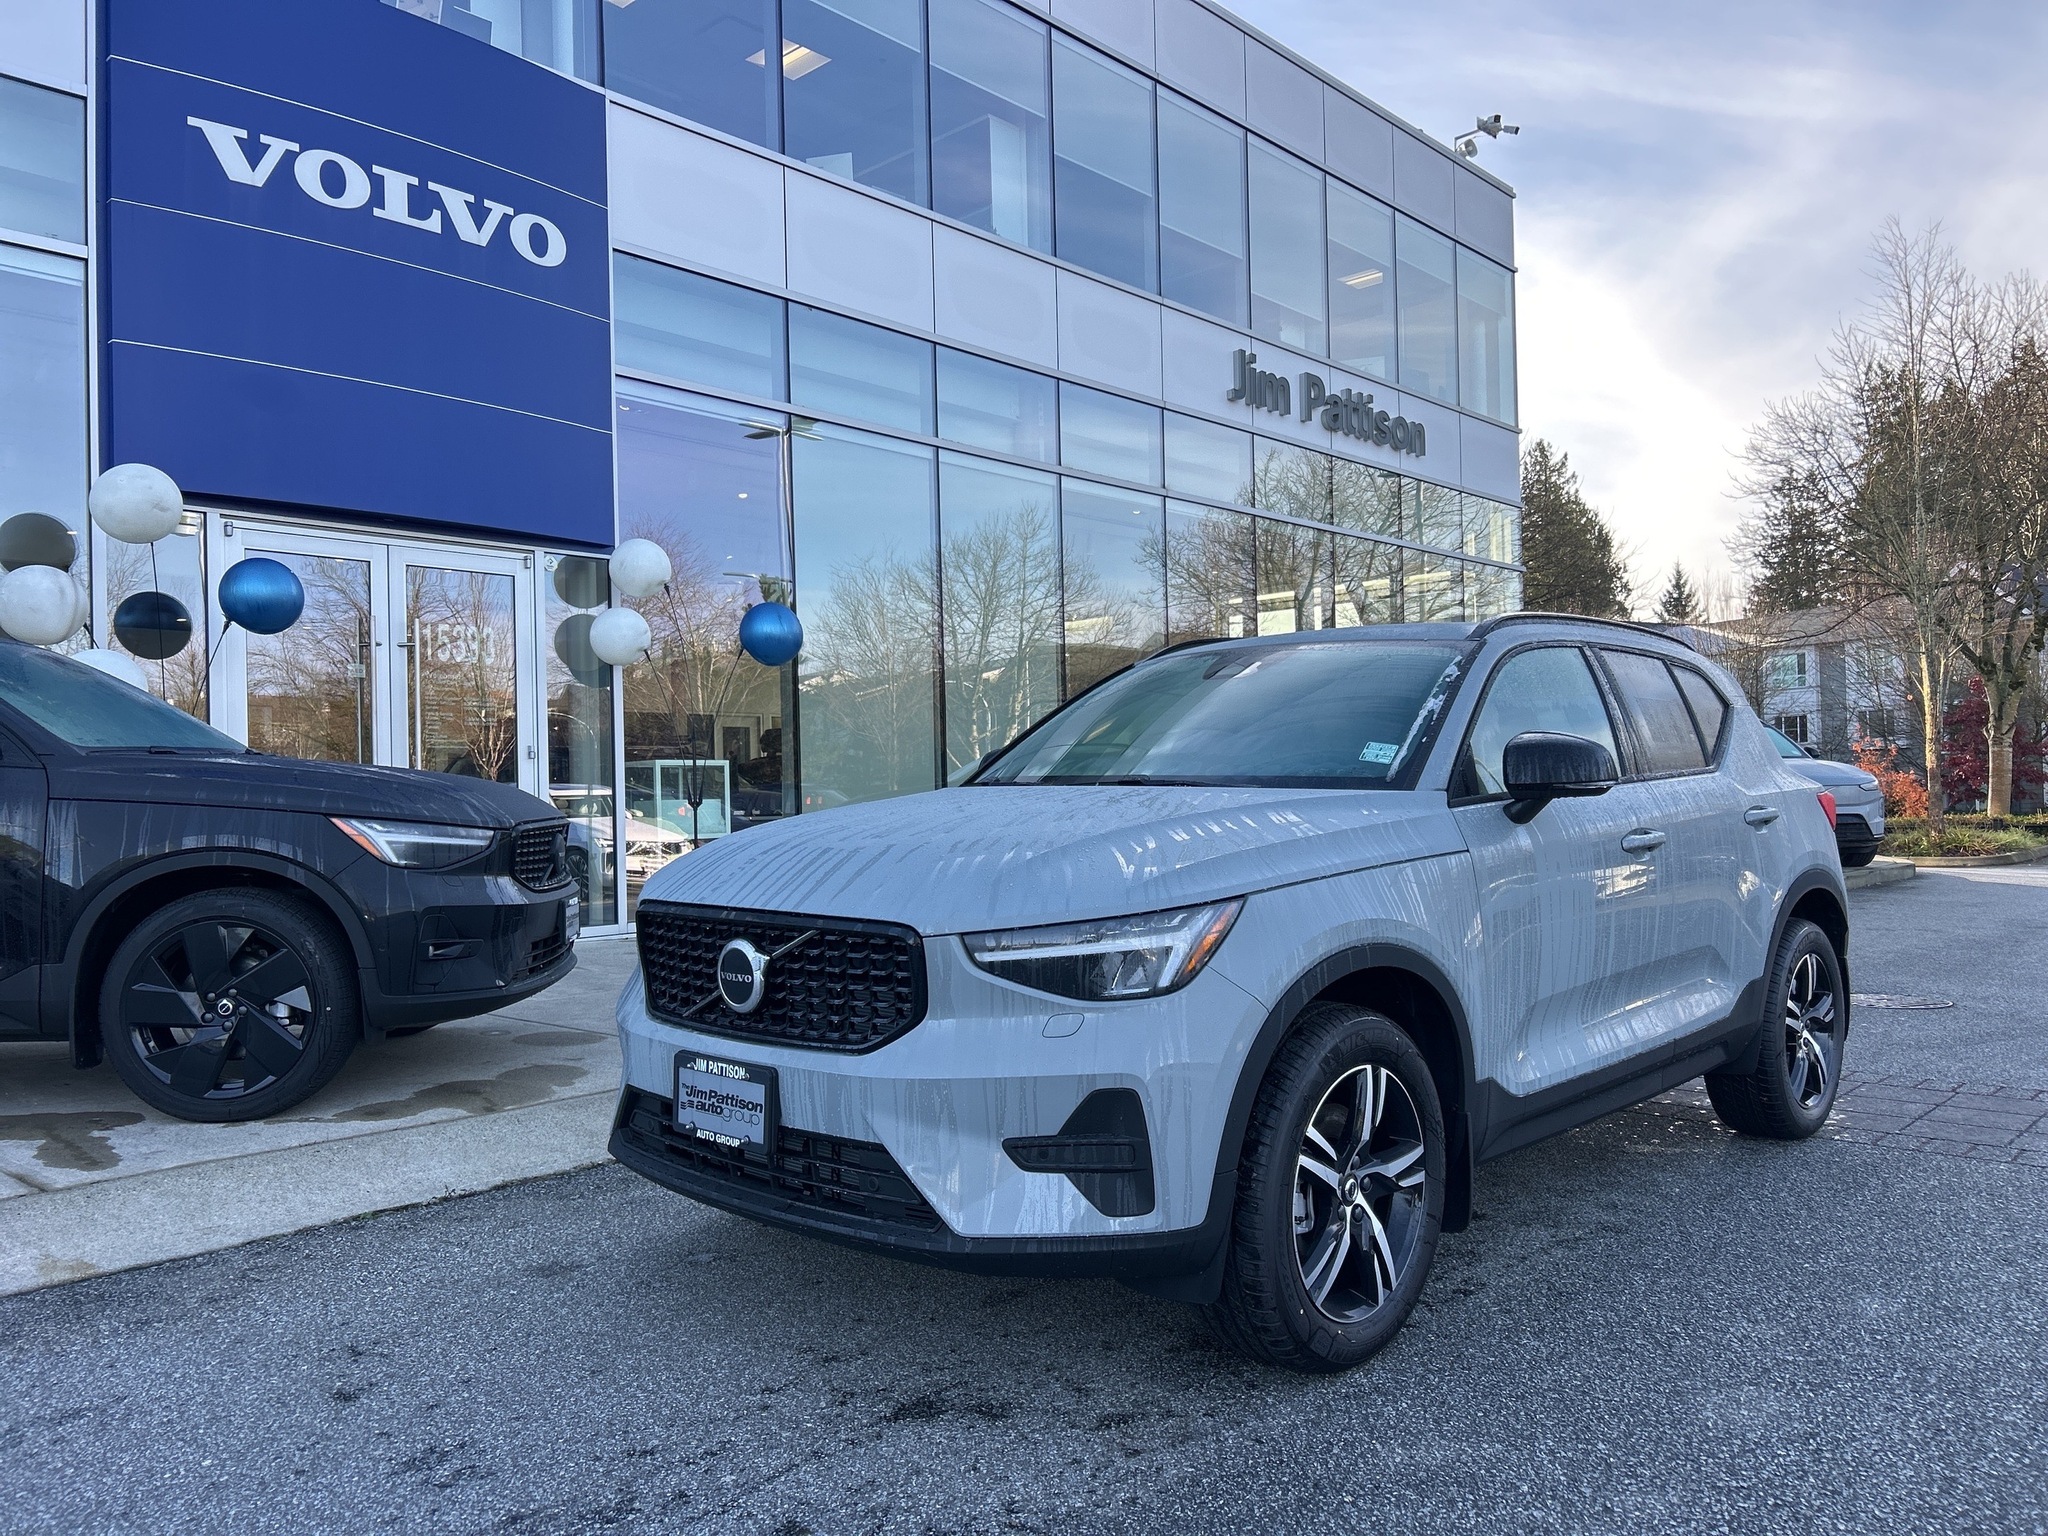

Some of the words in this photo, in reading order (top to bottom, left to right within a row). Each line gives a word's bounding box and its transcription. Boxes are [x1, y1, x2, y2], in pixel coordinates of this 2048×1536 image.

[187, 115, 567, 267] VOLVO
[1227, 348, 1291, 416] Jim
[1299, 371, 1426, 457] Pattison
[721, 971, 752, 983] VOLVO
[694, 1058, 707, 1073] JIM
[708, 1060, 746, 1080] PATTISON
[696, 1128, 715, 1142] AUTO
[716, 1134, 741, 1148] GROUP
